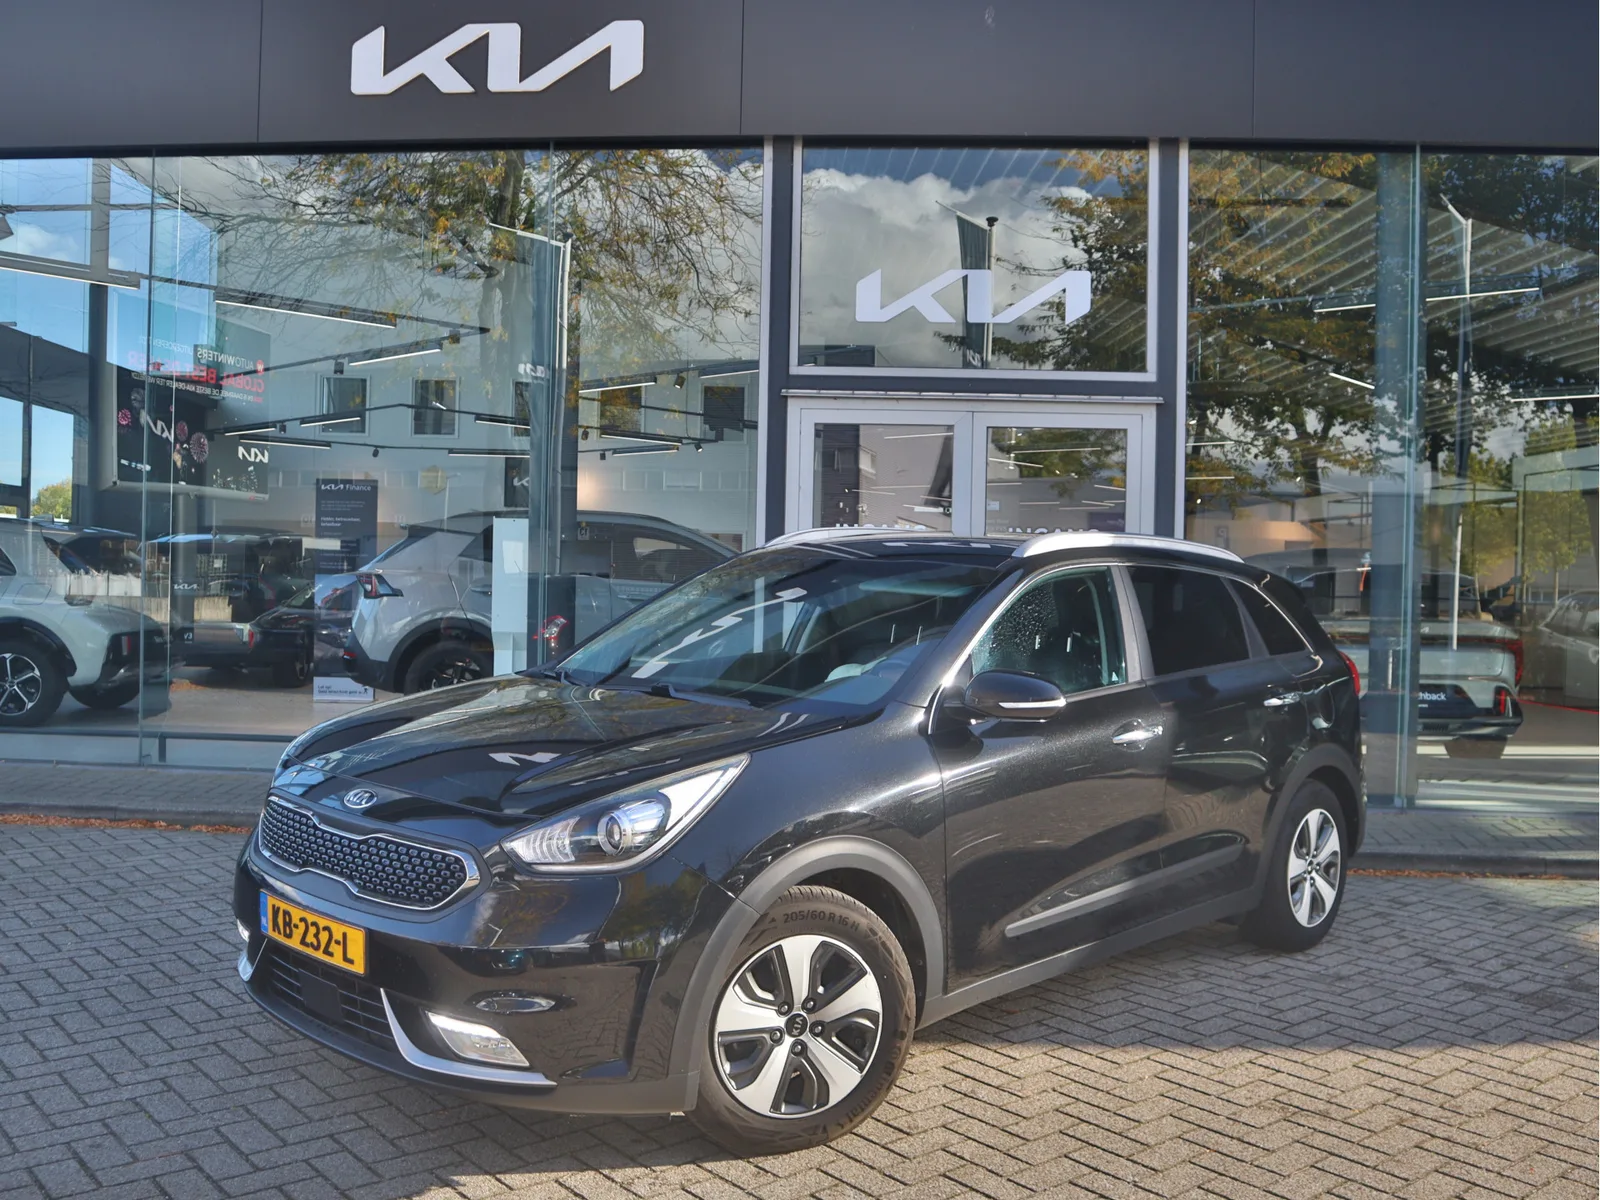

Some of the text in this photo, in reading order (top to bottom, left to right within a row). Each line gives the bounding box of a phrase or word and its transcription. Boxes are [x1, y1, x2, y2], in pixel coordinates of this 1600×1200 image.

[350, 20, 644, 95] KIA
[856, 268, 1091, 325] KIA
[321, 483, 372, 492] KIA Finance
[1418, 690, 1447, 701] hback
[783, 910, 826, 924] 205/60
[850, 920, 861, 932] H
[271, 903, 355, 966] KB-232-L
[791, 1016, 804, 1036] KIA
